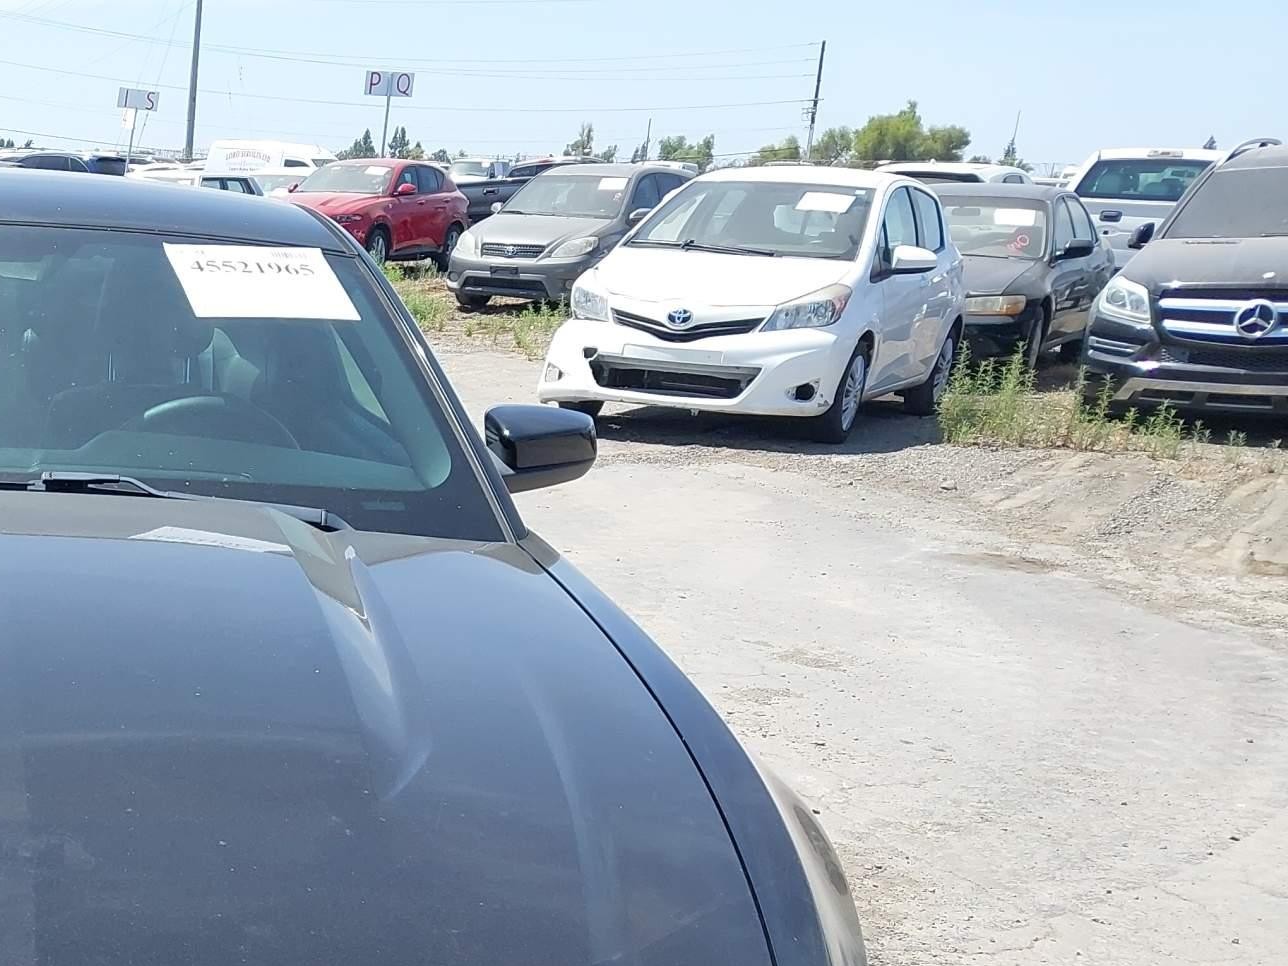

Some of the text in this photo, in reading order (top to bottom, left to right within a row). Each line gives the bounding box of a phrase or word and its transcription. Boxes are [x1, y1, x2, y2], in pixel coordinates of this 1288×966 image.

[368, 71, 411, 96] P Q
[145, 91, 155, 111] S
[191, 260, 315, 276] 45521965
